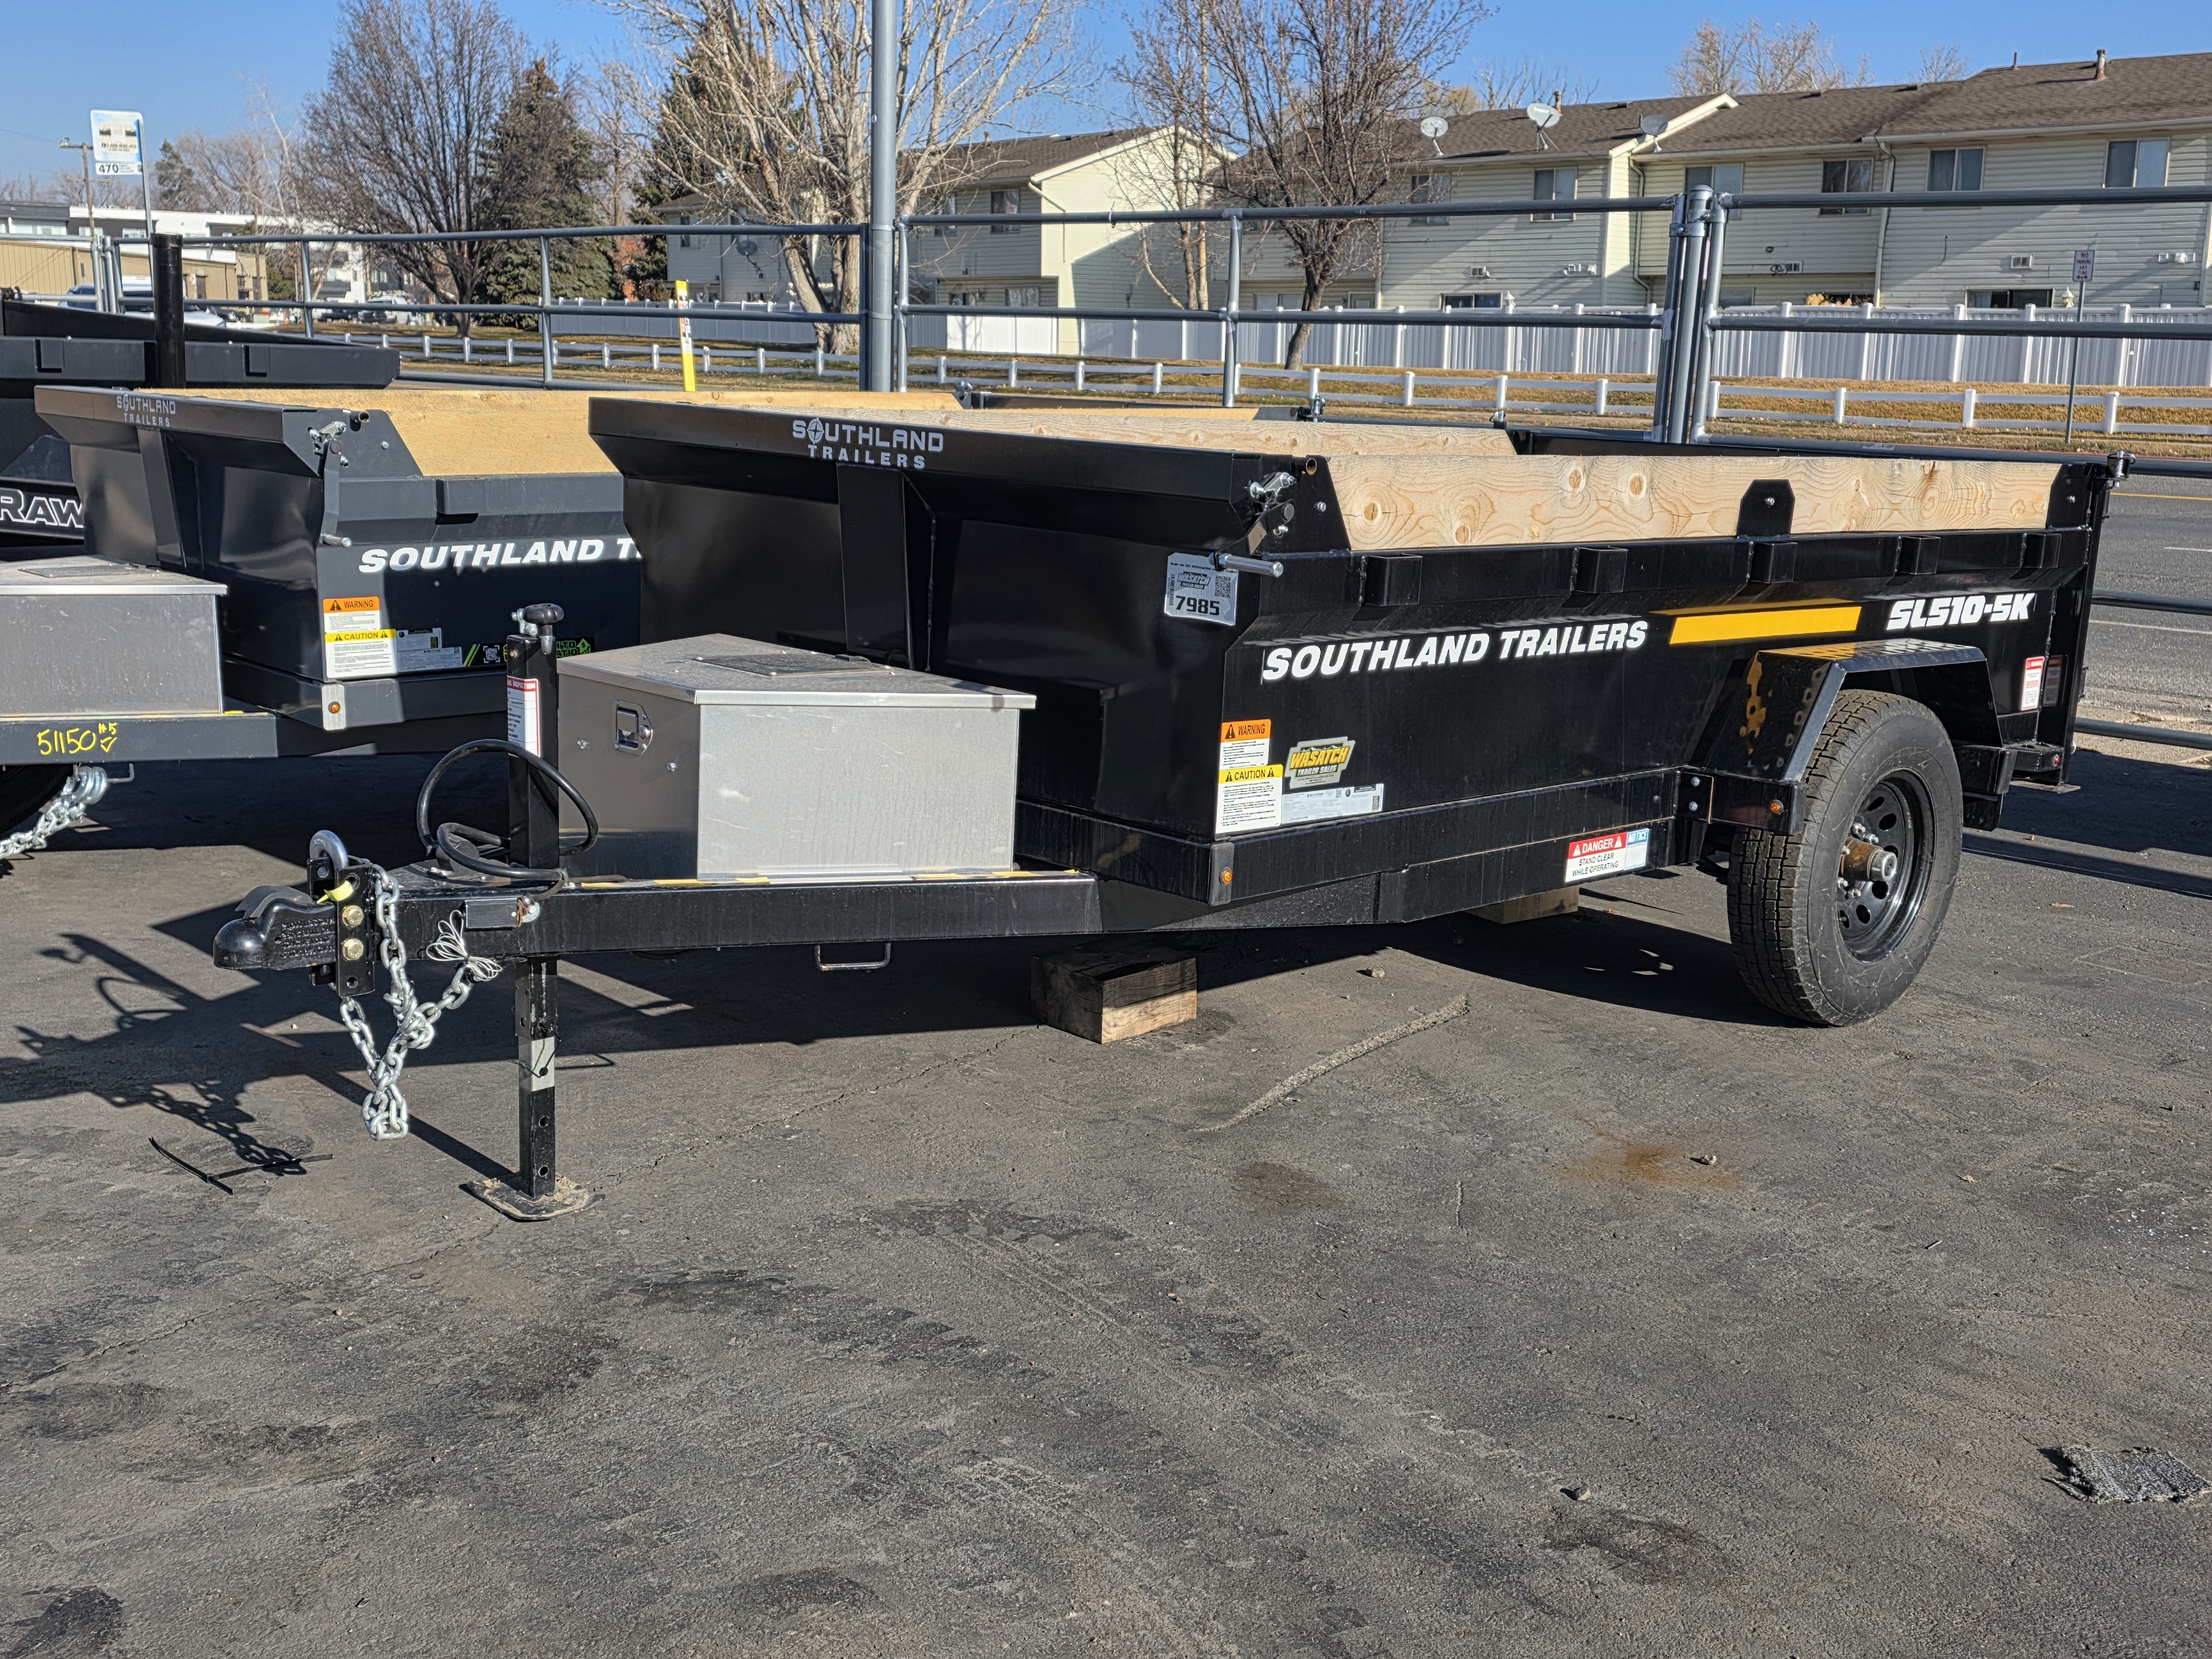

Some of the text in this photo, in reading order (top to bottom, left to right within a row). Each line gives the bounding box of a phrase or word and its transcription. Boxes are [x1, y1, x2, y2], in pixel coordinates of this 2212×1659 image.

[99, 164, 118, 173] 470
[116, 394, 176, 414] SOUTHLAND
[124, 413, 170, 427] TRAILERS
[792, 418, 943, 452] SOUTHLAND
[808, 445, 925, 469] TRAILERS
[358, 538, 641, 573] SOUTHLAND T
[1177, 573, 1211, 586] WASATCH
[343, 599, 373, 609] WARNING
[1176, 595, 1220, 615] 7985
[1887, 593, 2036, 630] SL510-5K
[344, 632, 378, 640] CAUTION
[1263, 620, 1648, 680] SOUTHLAND TRAILERS
[1238, 723, 1265, 735] WARNING
[37, 728, 96, 755] 51150
[1290, 747, 1350, 770] WASATCH
[1234, 769, 1266, 780] CAUTION
[1297, 767, 1319, 776] TRAILER
[1582, 831, 1647, 854] DANGER NOTICE
[1579, 853, 1614, 866] STAND CLEAR
[1572, 861, 1619, 877] WHILE OPERATING
